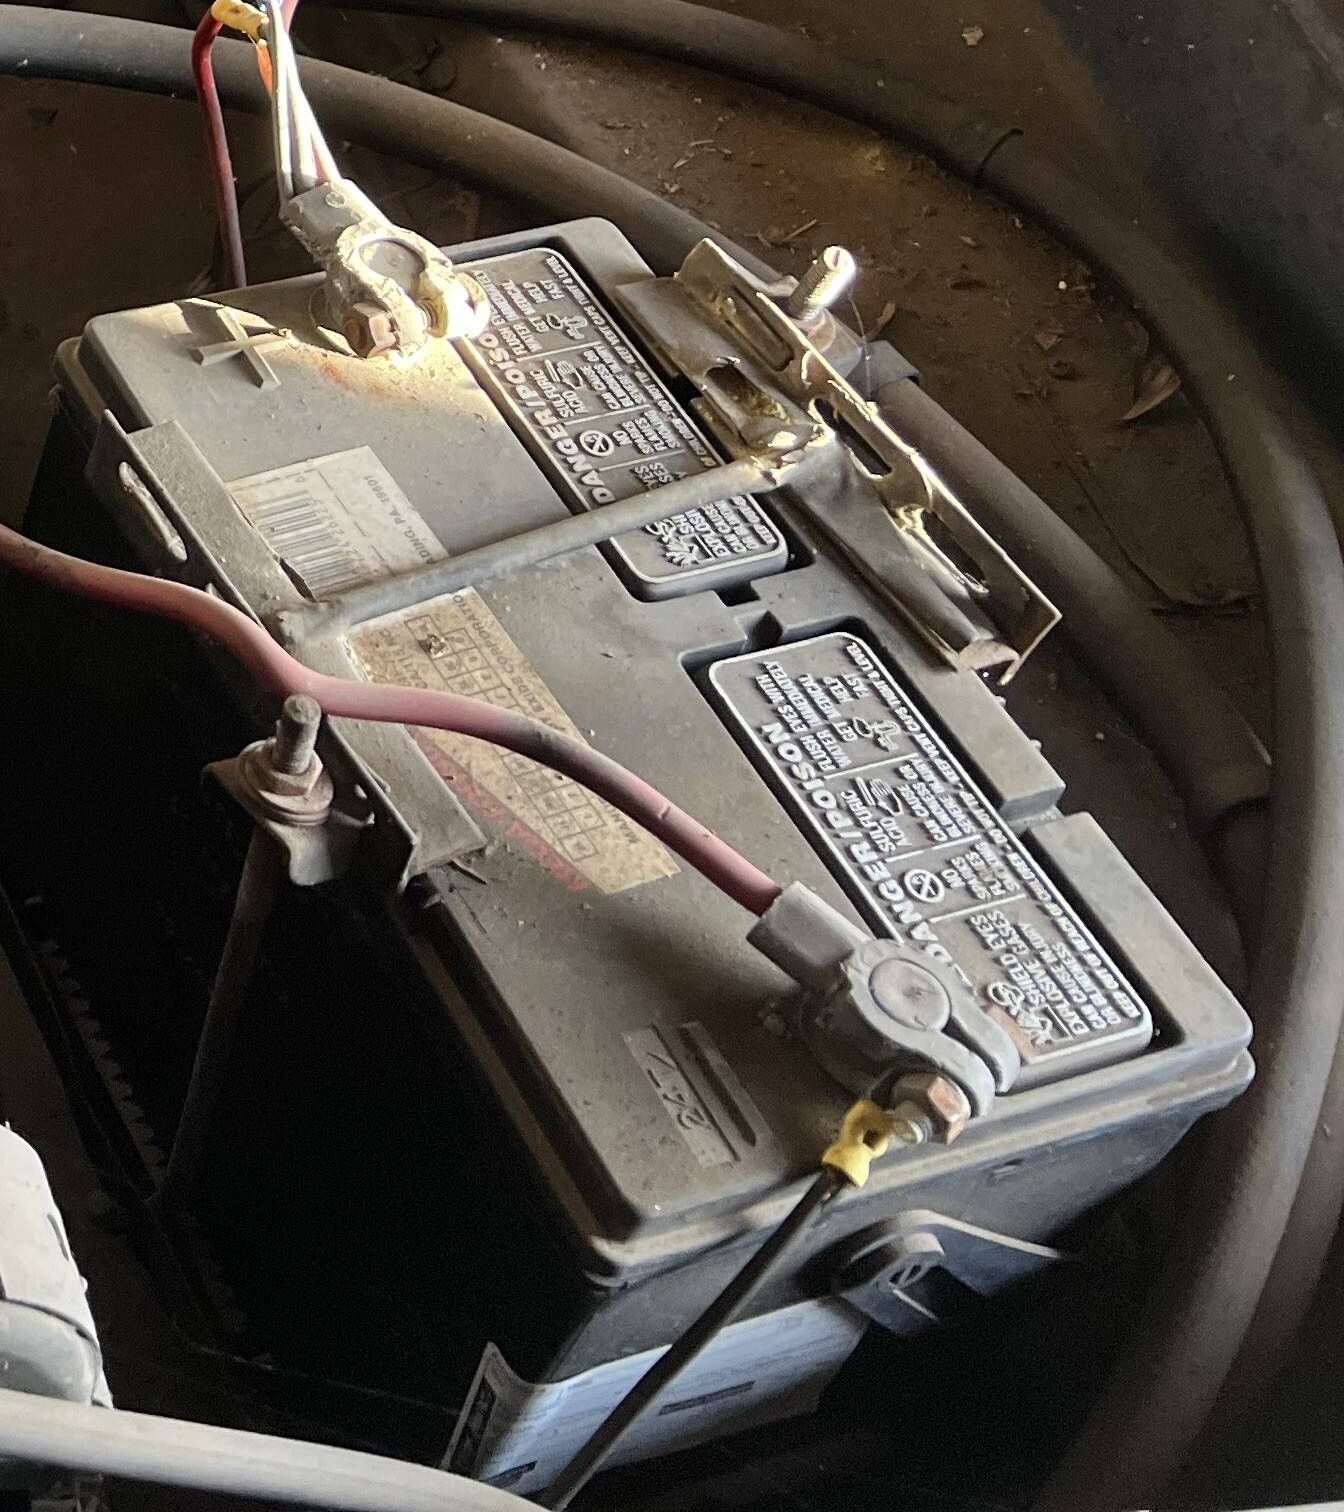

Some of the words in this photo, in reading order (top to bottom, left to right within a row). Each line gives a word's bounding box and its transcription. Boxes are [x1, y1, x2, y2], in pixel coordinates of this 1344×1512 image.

[499, 279, 536, 315] MEDICAL
[520, 280, 549, 303] HELP
[538, 277, 566, 299] FAST
[527, 315, 551, 333] GET
[582, 305, 606, 325] CAPS
[496, 325, 528, 355] FLUSH
[511, 322, 543, 352] WATER
[597, 324, 622, 345] VENT
[592, 343, 624, 374] INJURY
[613, 344, 637, 364] KEEP
[578, 364, 608, 391] CAUSE
[592, 362, 635, 407] BLINDNESS
[614, 373, 648, 404] SEVERE
[643, 383, 665, 400] NOT
[528, 368, 576, 418] SULFURIC
[560, 389, 589, 415] ACID
[599, 391, 622, 410] CAN
[655, 398, 674, 412] DO
[473, 330, 616, 504] DANGER/POISO
[642, 409, 681, 448] SMOKING
[610, 429, 633, 445] NO
[620, 420, 655, 454] SPARKS
[632, 416, 668, 451] FLAMES
[670, 417, 708, 456] CHILDREN
[683, 507, 731, 557] EXPLOSI
[722, 532, 747, 553] CAN
[751, 521, 777, 544] KEEP
[449, 592, 517, 674] CORPORATIO
[842, 641, 875, 671] LEVEL
[509, 675, 545, 713] EXIDE
[752, 673, 787, 703] WITH
[759, 658, 825, 727] IMMEDIATELY
[794, 671, 843, 719] MEDICAL
[819, 673, 855, 704] HELP
[840, 671, 873, 699] FAST
[871, 678, 903, 707] TIGHT
[775, 703, 810, 733] EYES
[830, 718, 859, 742] GET
[892, 705, 923, 733] CAPS
[797, 733, 838, 771] FLUSH
[813, 729, 854, 767] WATER
[912, 731, 942, 757] VENT
[896, 763, 919, 780] OR
[907, 756, 947, 794] INJURY
[930, 755, 961, 783] KEEP
[894, 783, 931, 818] CAUSE
[910, 781, 964, 838] BLINDNESS
[956, 789, 981, 808] TIP
[836, 788, 899, 853] SULFURIC
[937, 794, 978, 834] SEVERE
[970, 807, 997, 829] NOT
[757, 720, 955, 966] DANGER/POISON
[876, 815, 913, 848] ACID
[921, 818, 950, 842] CAN
[986, 828, 1009, 844] DO
[938, 867, 967, 888] NO
[948, 855, 993, 900] SPARKS
[962, 850, 1008, 896] FLAMES
[972, 840, 1022, 892] SMOKING
[1003, 851, 1053, 901] CHILDREN
[1042, 900, 1064, 916] OF
[967, 913, 1009, 950] EYES
[984, 909, 1032, 955] GASES
[1015, 920, 1057, 960] INJURY
[1048, 941, 1108, 1005] BLINDNESS
[1080, 950, 1103, 967] OF
[996, 952, 1050, 1006] SHIELD
[1045, 960, 1089, 1003] CAUSE
[1092, 966, 1121, 990] OUT
[1020, 958, 1091, 1035] EXPLOSIVE
[1110, 988, 1143, 1018] KEEP
[1079, 1003, 1109, 1029] CAN
[1096, 1003, 1123, 1025] OR
